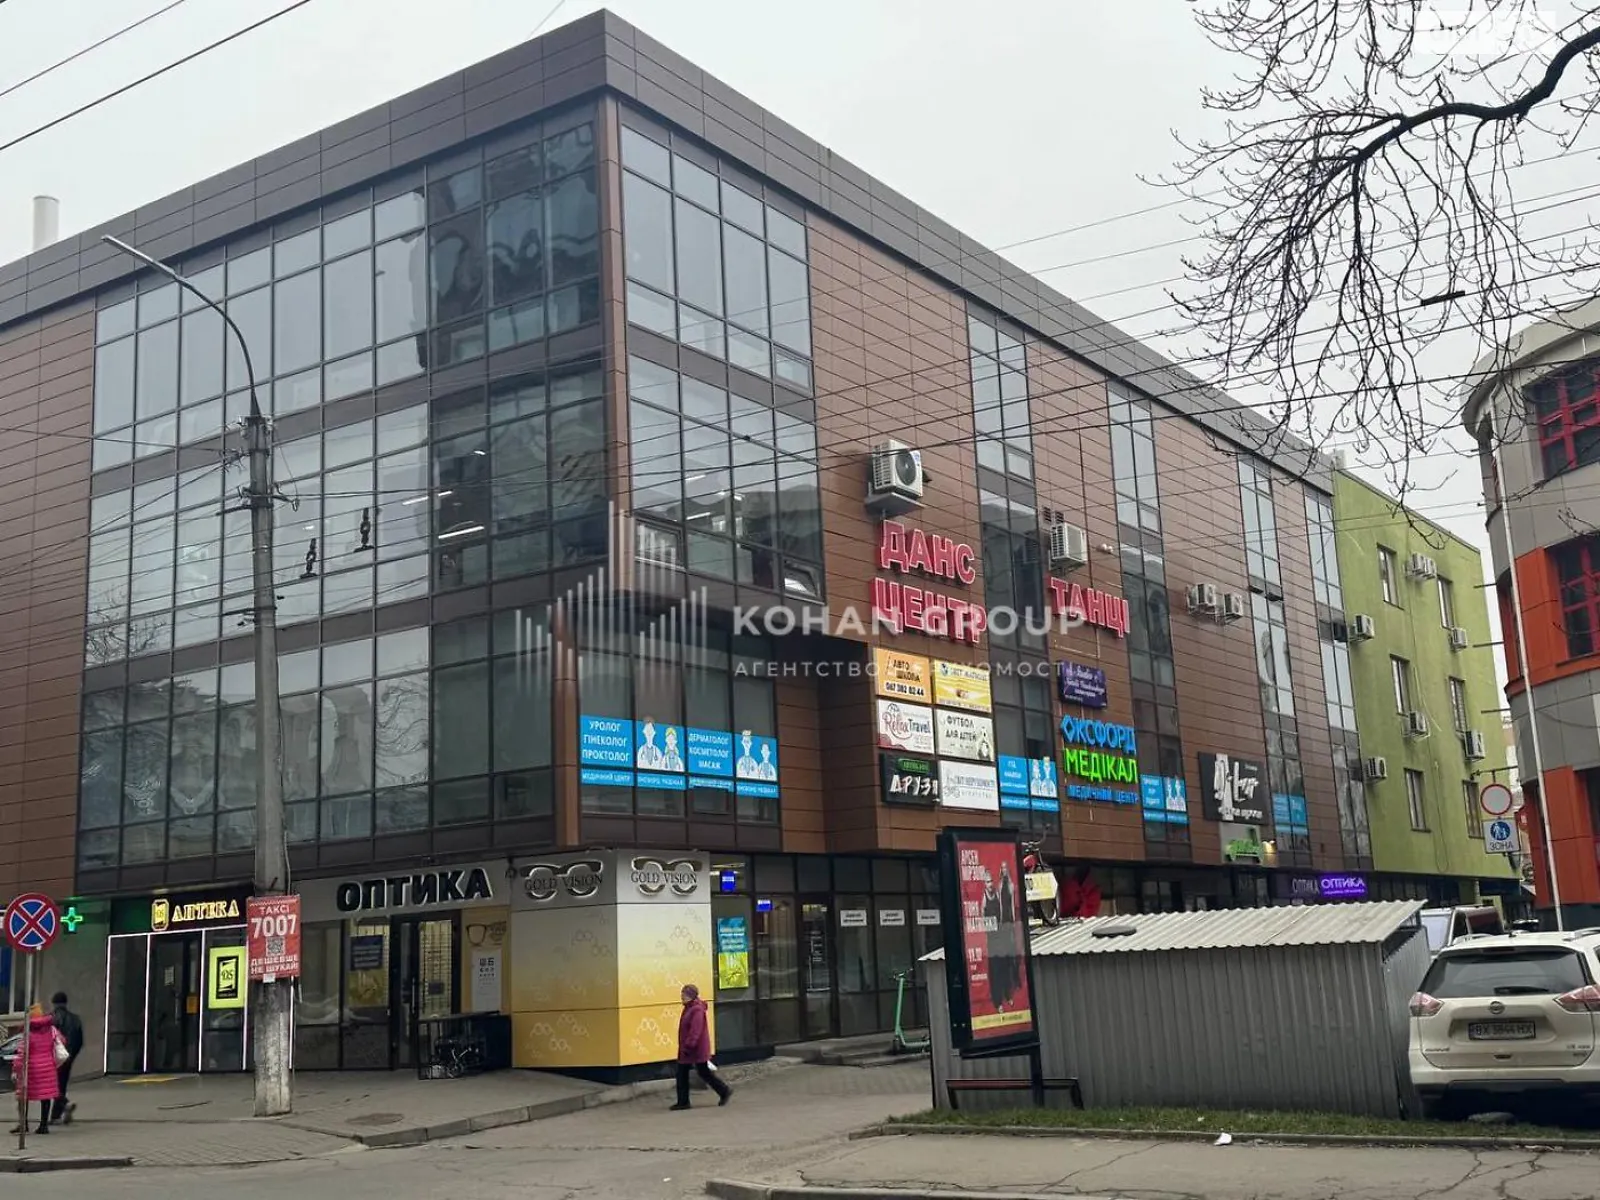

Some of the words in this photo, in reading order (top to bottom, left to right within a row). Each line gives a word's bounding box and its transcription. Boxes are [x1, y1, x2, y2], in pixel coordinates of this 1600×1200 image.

[879, 519, 976, 585] ДАНС
[872, 577, 988, 644] ЦЕНТР
[1049, 577, 1131, 639] ТАНЦІ
[589, 719, 622, 733] УРОЛОГ
[946, 715, 974, 728] ФУТБОЛ
[688, 733, 729, 746] ДЕРМАТОЛОГ
[945, 729, 959, 738] ДЛЯ
[1061, 715, 1137, 755] ОКСФОРД
[583, 734, 627, 748] ГІНЕКОЛОГ
[582, 749, 630, 762] ПРОКТОЛОГ
[689, 746, 729, 759] КОСМЕТОЛОГ
[1063, 748, 1139, 784] МЕДІКАЛ
[1068, 784, 1112, 801] МЕДИЧНИЙ
[1116, 790, 1140, 804] ЦЕНТР
[1489, 842, 1514, 851] ЗОНА
[524, 877, 558, 891] GOLD
[562, 873, 603, 888] VISION
[630, 871, 660, 885] GOLD
[664, 871, 698, 884] VISION
[1320, 877, 1366, 889] ОПТИКА
[336, 867, 493, 913] ОПТИКА
[171, 899, 240, 922] АПТЕКА
[259, 904, 290, 915] ТАКСІ
[250, 914, 297, 939] 7007
[250, 955, 298, 967] ДЕШЕВШЕ
[250, 966, 265, 975] НЕ
